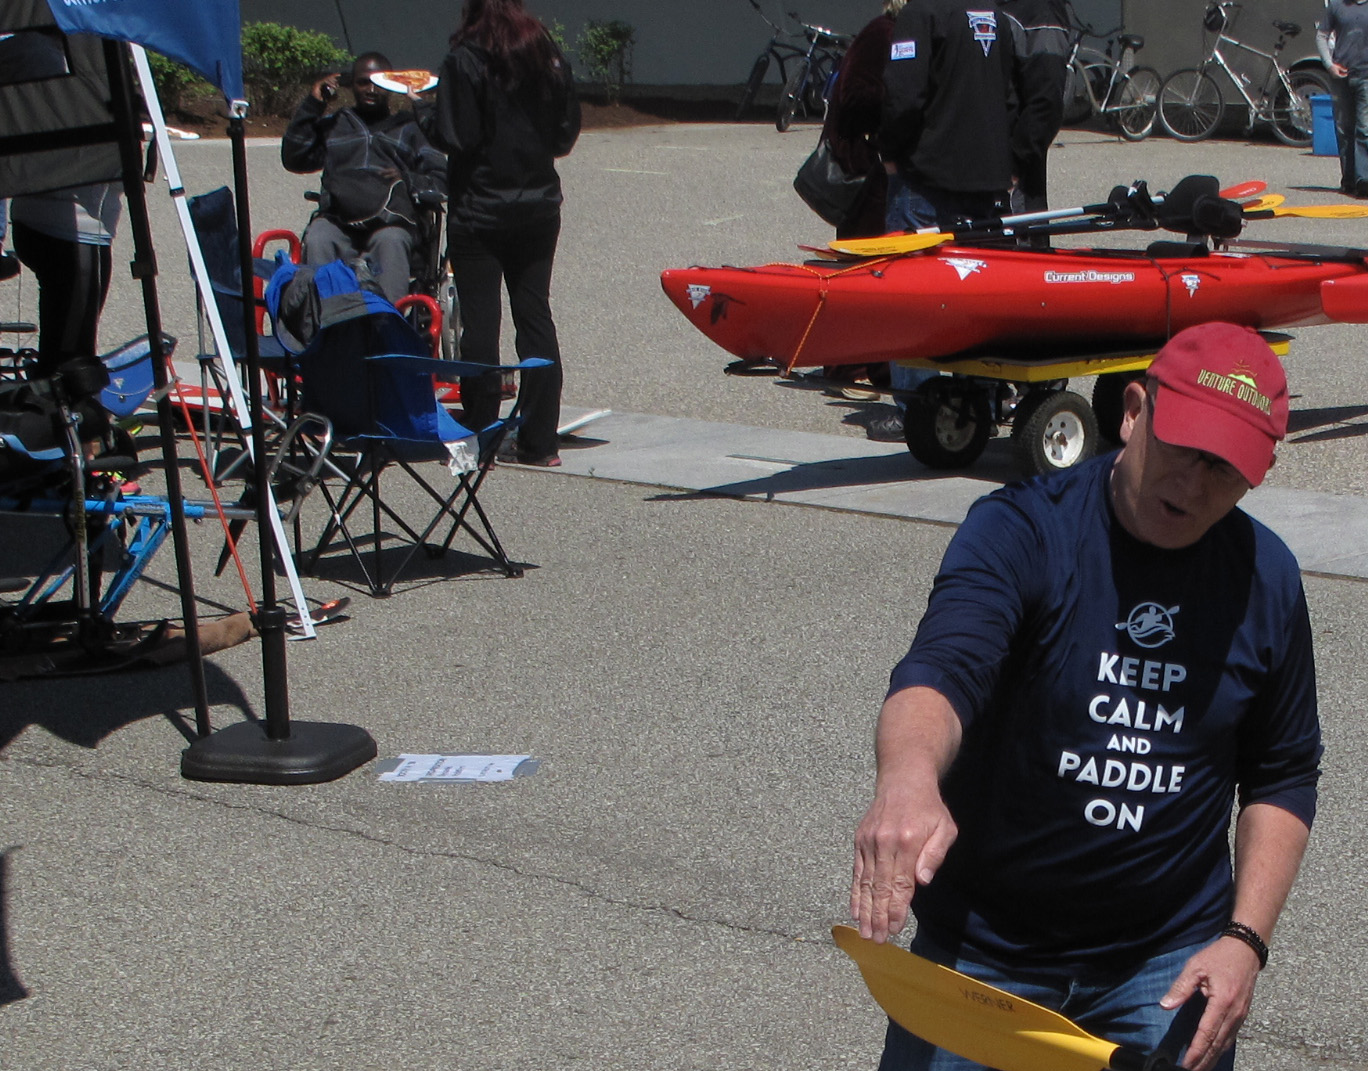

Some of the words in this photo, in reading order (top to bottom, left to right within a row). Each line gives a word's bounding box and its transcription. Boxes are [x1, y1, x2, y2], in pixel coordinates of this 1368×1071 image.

[1045, 270, 1087, 283] Current
[1088, 270, 1134, 284] Designs
[1197, 369, 1236, 396] VENTURE
[1097, 652, 1187, 692] KEEP
[1088, 694, 1185, 734] CALM
[1106, 733, 1152, 755] AND
[1057, 751, 1185, 793] PADDLE
[1084, 798, 1145, 832] ON
[959, 987, 1016, 1013] WERNER
